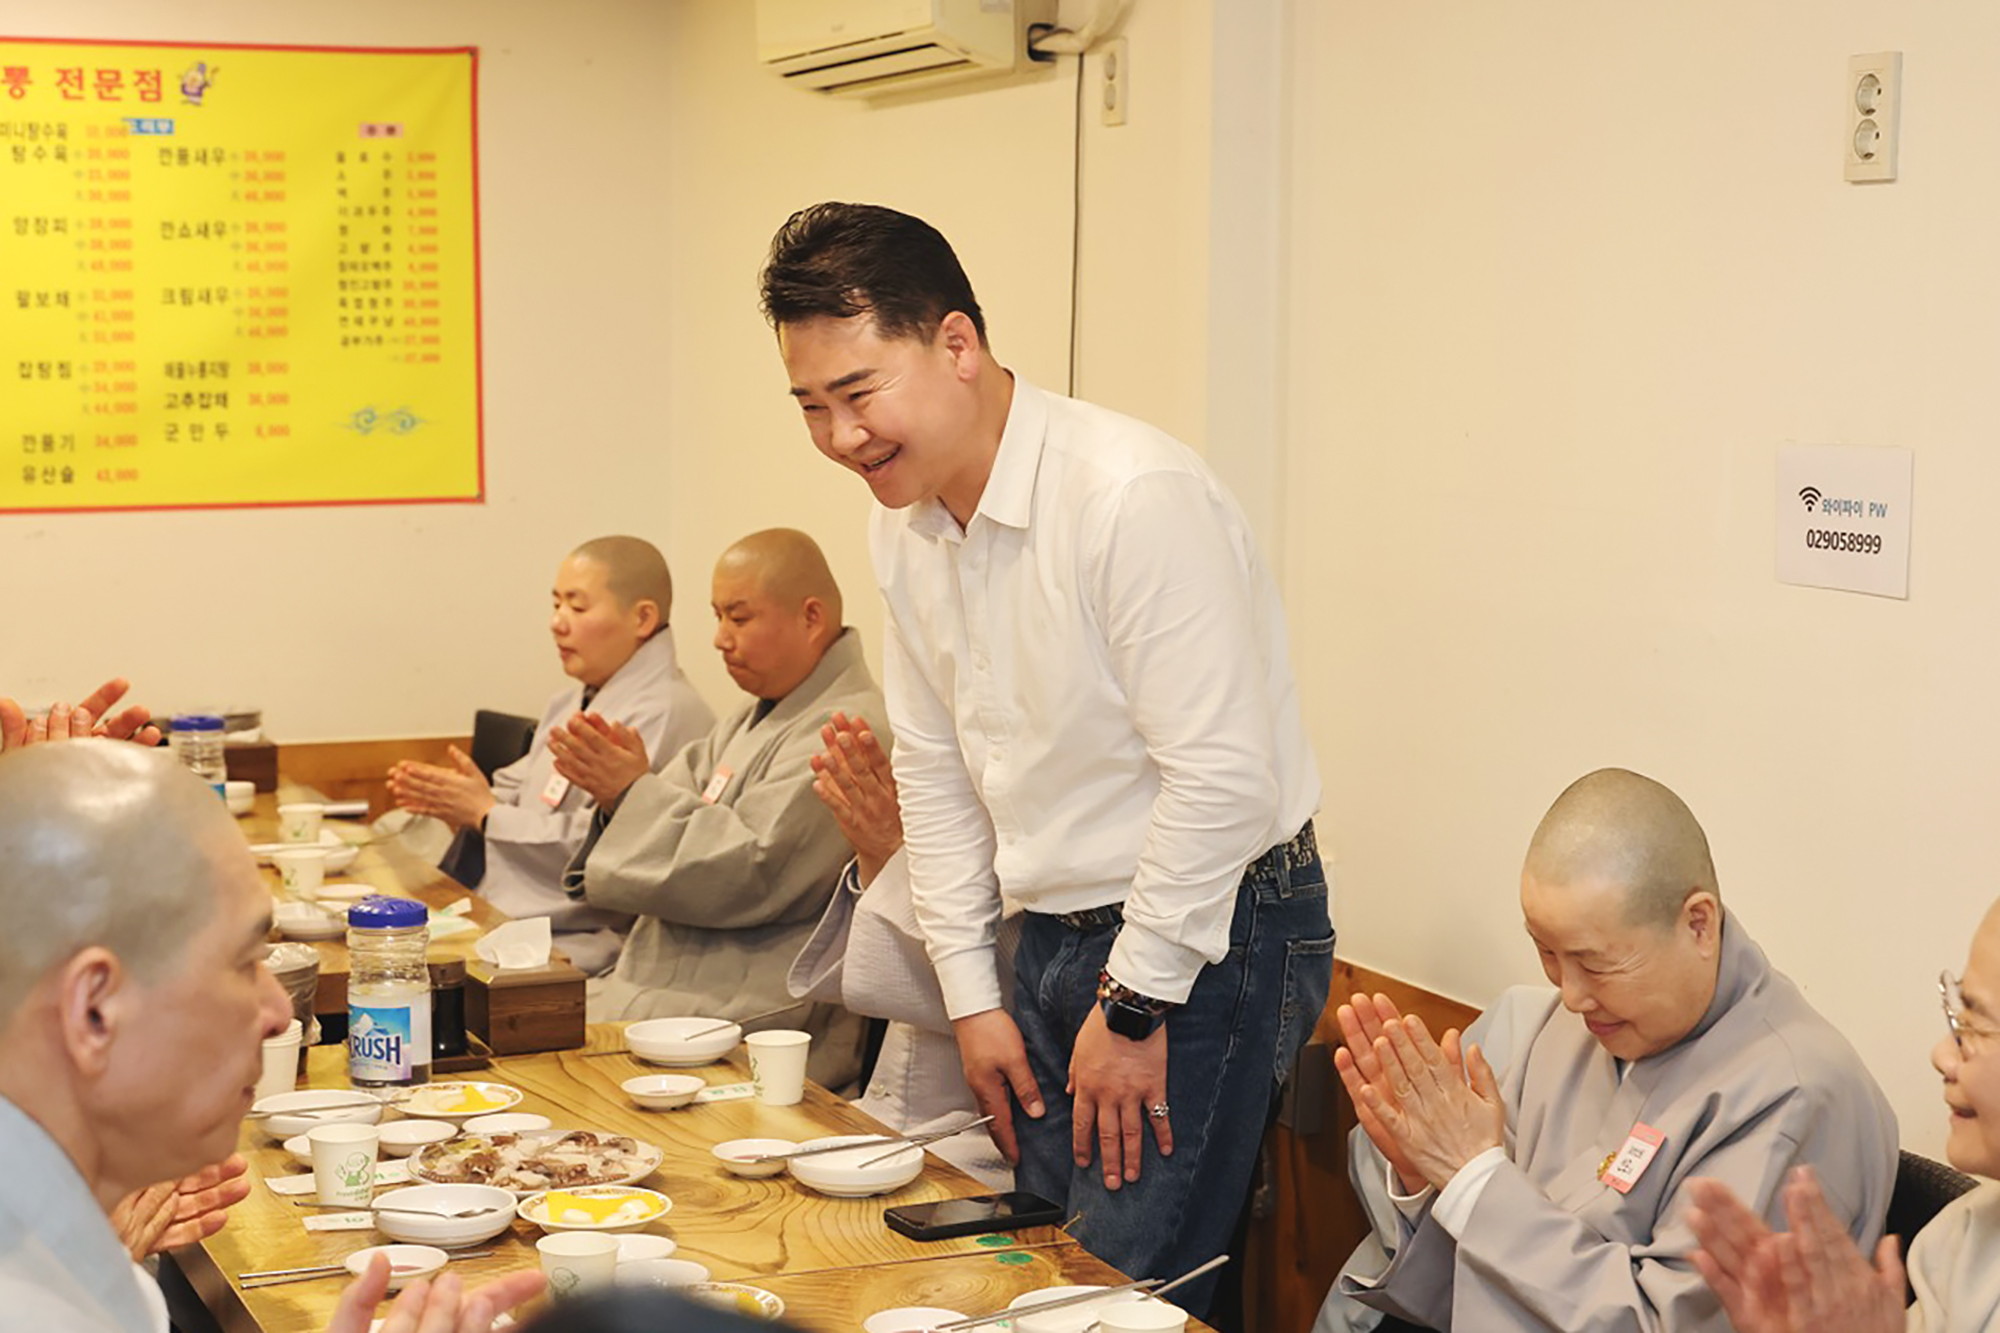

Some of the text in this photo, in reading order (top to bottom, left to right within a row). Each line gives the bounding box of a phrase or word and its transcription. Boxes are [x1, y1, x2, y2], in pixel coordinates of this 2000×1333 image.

[55, 66, 163, 103] 전문점
[11, 144, 68, 164] 탕수육
[12, 216, 68, 237] 양장피
[16, 290, 70, 310] 팔보채
[162, 286, 229, 307] 크림새우
[165, 391, 229, 410] 고추잡채
[164, 421, 230, 443] 군만두
[22, 433, 75, 454] 깐풍기
[22, 465, 75, 485] 유산슬
[1821, 498, 1887, 518] 와이파이 PW
[1806, 528, 1882, 555] 029058999
